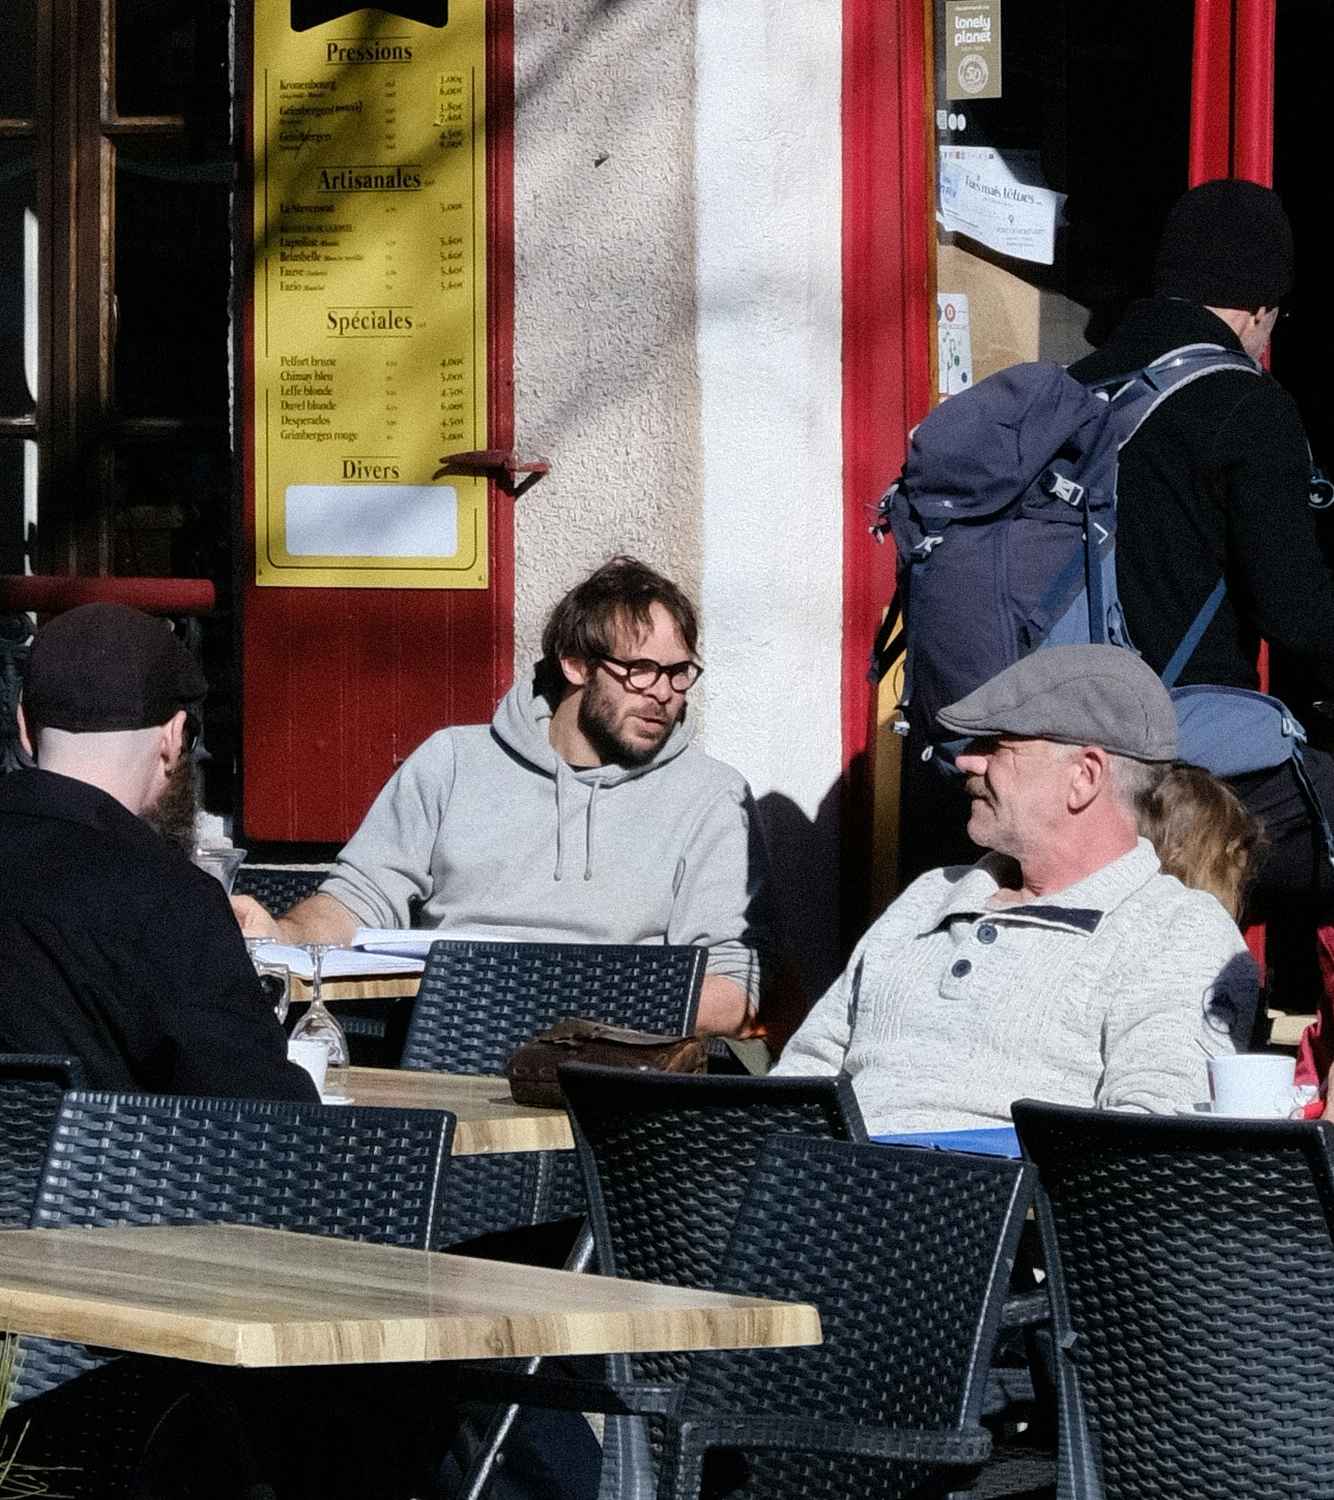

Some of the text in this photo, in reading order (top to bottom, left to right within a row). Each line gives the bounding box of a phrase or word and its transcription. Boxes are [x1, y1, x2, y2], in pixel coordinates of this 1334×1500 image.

[954, 14, 991, 31] lonely
[954, 30, 992, 47] planet
[327, 42, 413, 63] Pressions
[318, 168, 421, 190] Artisanales
[327, 309, 413, 336] Spéciales
[342, 459, 400, 479] Divers
